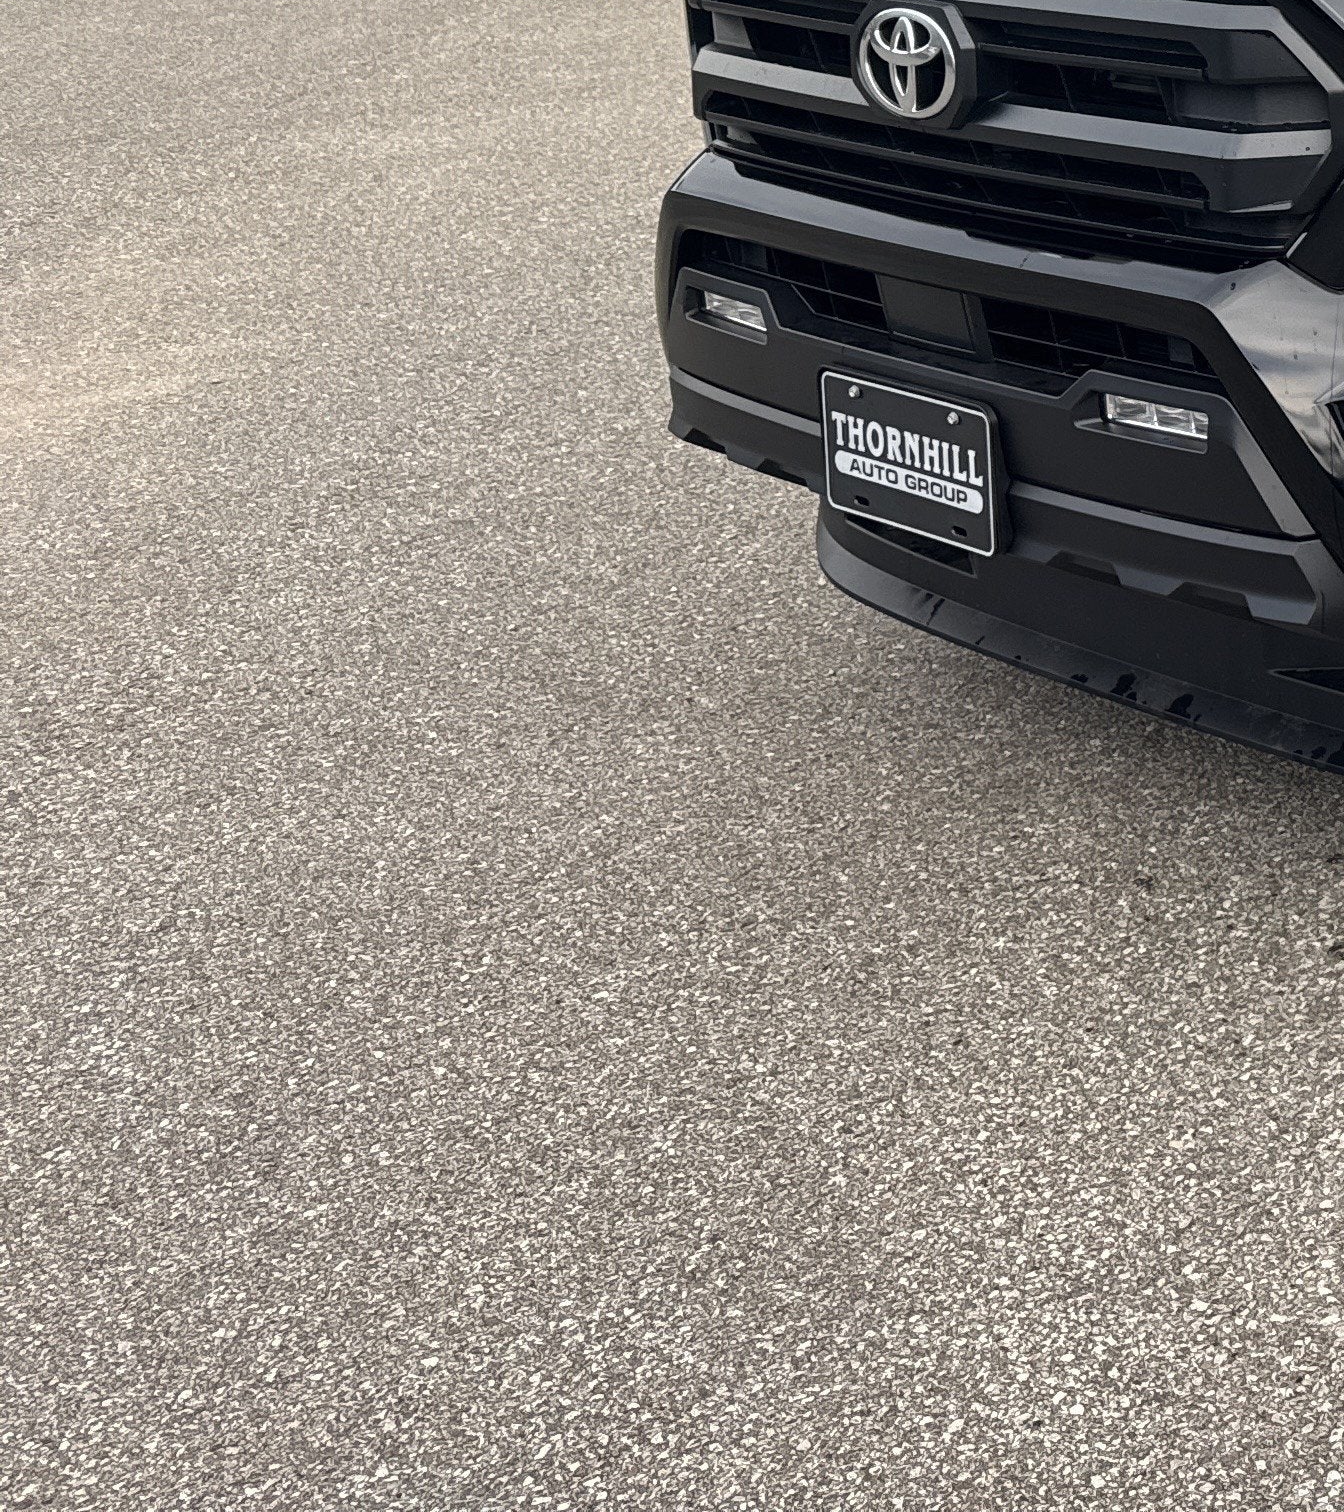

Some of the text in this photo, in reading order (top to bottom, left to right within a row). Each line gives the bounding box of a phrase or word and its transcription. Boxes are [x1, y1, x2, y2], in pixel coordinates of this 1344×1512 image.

[831, 410, 984, 487] THORNHILL
[850, 458, 968, 505] AUTO GROUP
